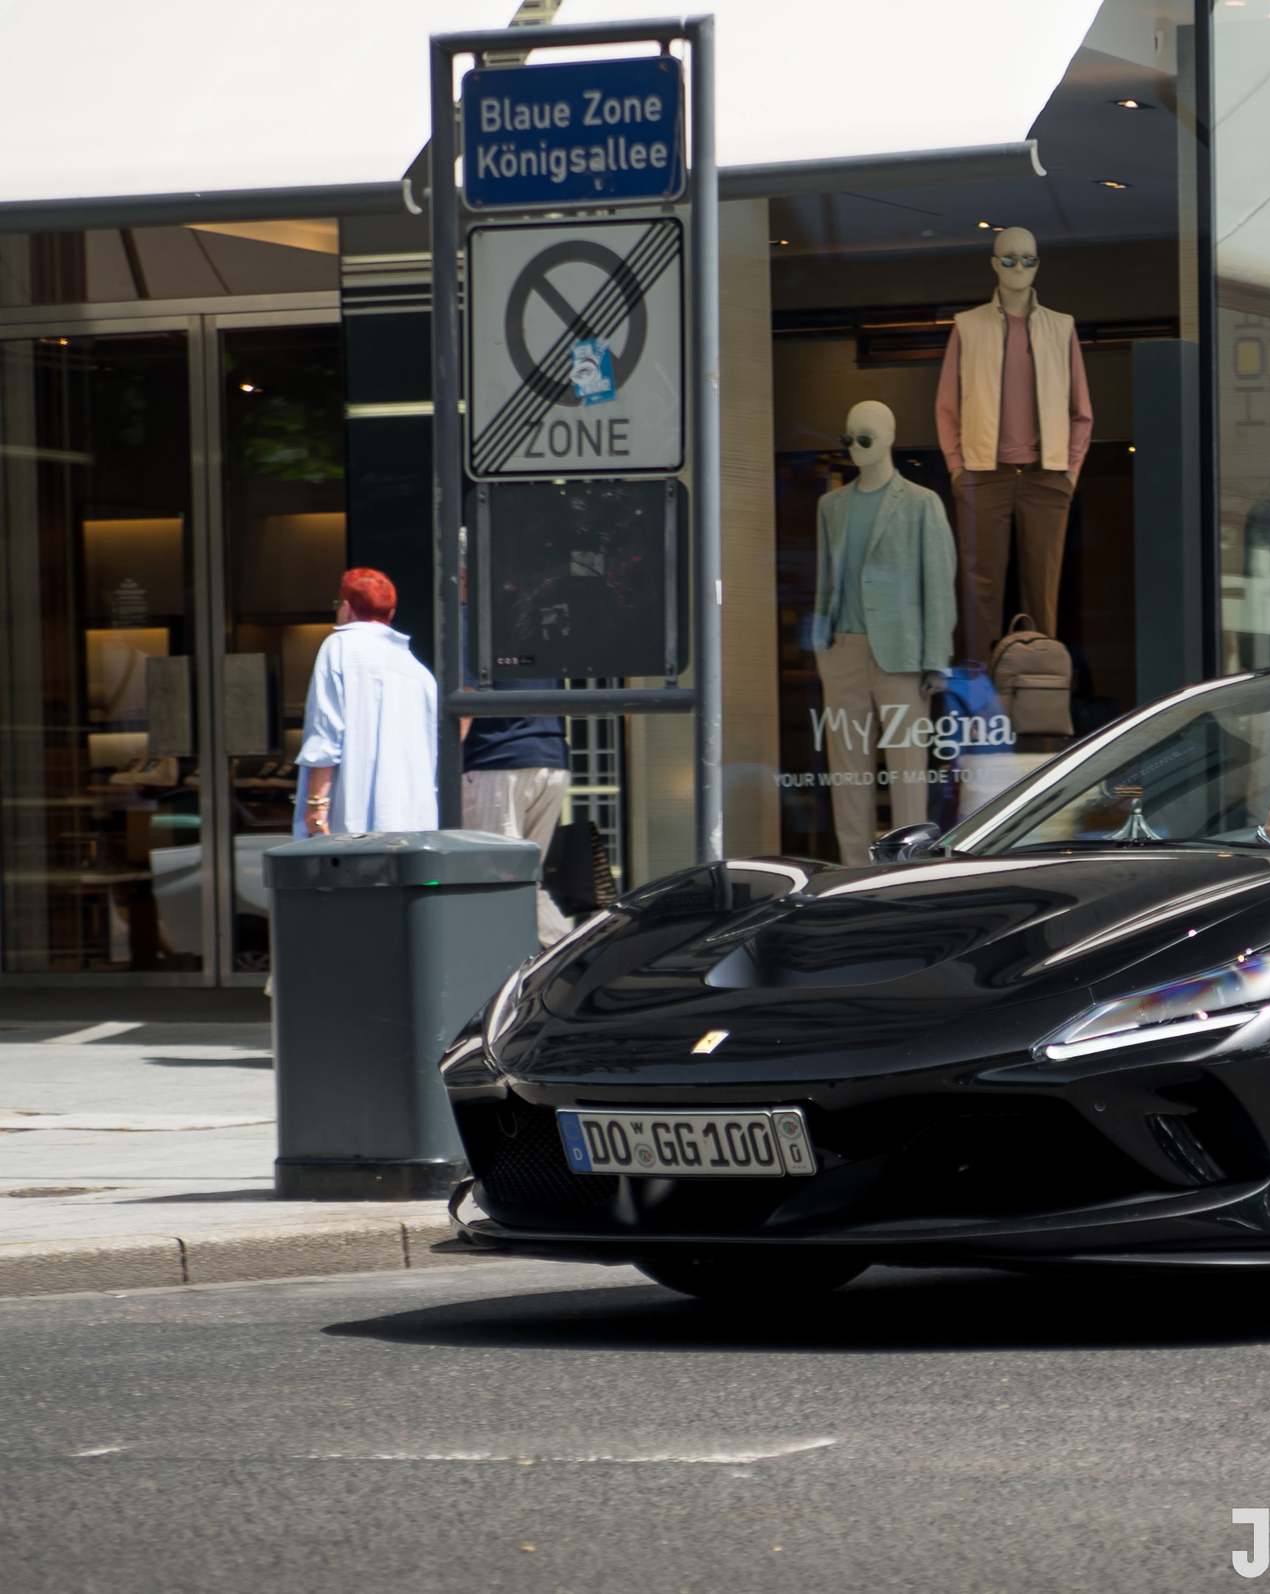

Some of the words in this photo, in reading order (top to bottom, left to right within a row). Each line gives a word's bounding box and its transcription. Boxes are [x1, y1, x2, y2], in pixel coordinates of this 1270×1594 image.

[480, 96, 571, 132] Blaue
[582, 90, 662, 126] Zone
[477, 135, 668, 183] Königsallee
[524, 418, 631, 459] ZONE
[772, 773, 815, 788] YOUR
[817, 772, 874, 787] WORLD
[877, 770, 898, 786] OF
[903, 769, 949, 784] MADE
[953, 769, 972, 783] TO
[573, 1148, 583, 1161] D
[582, 1120, 633, 1167] DO
